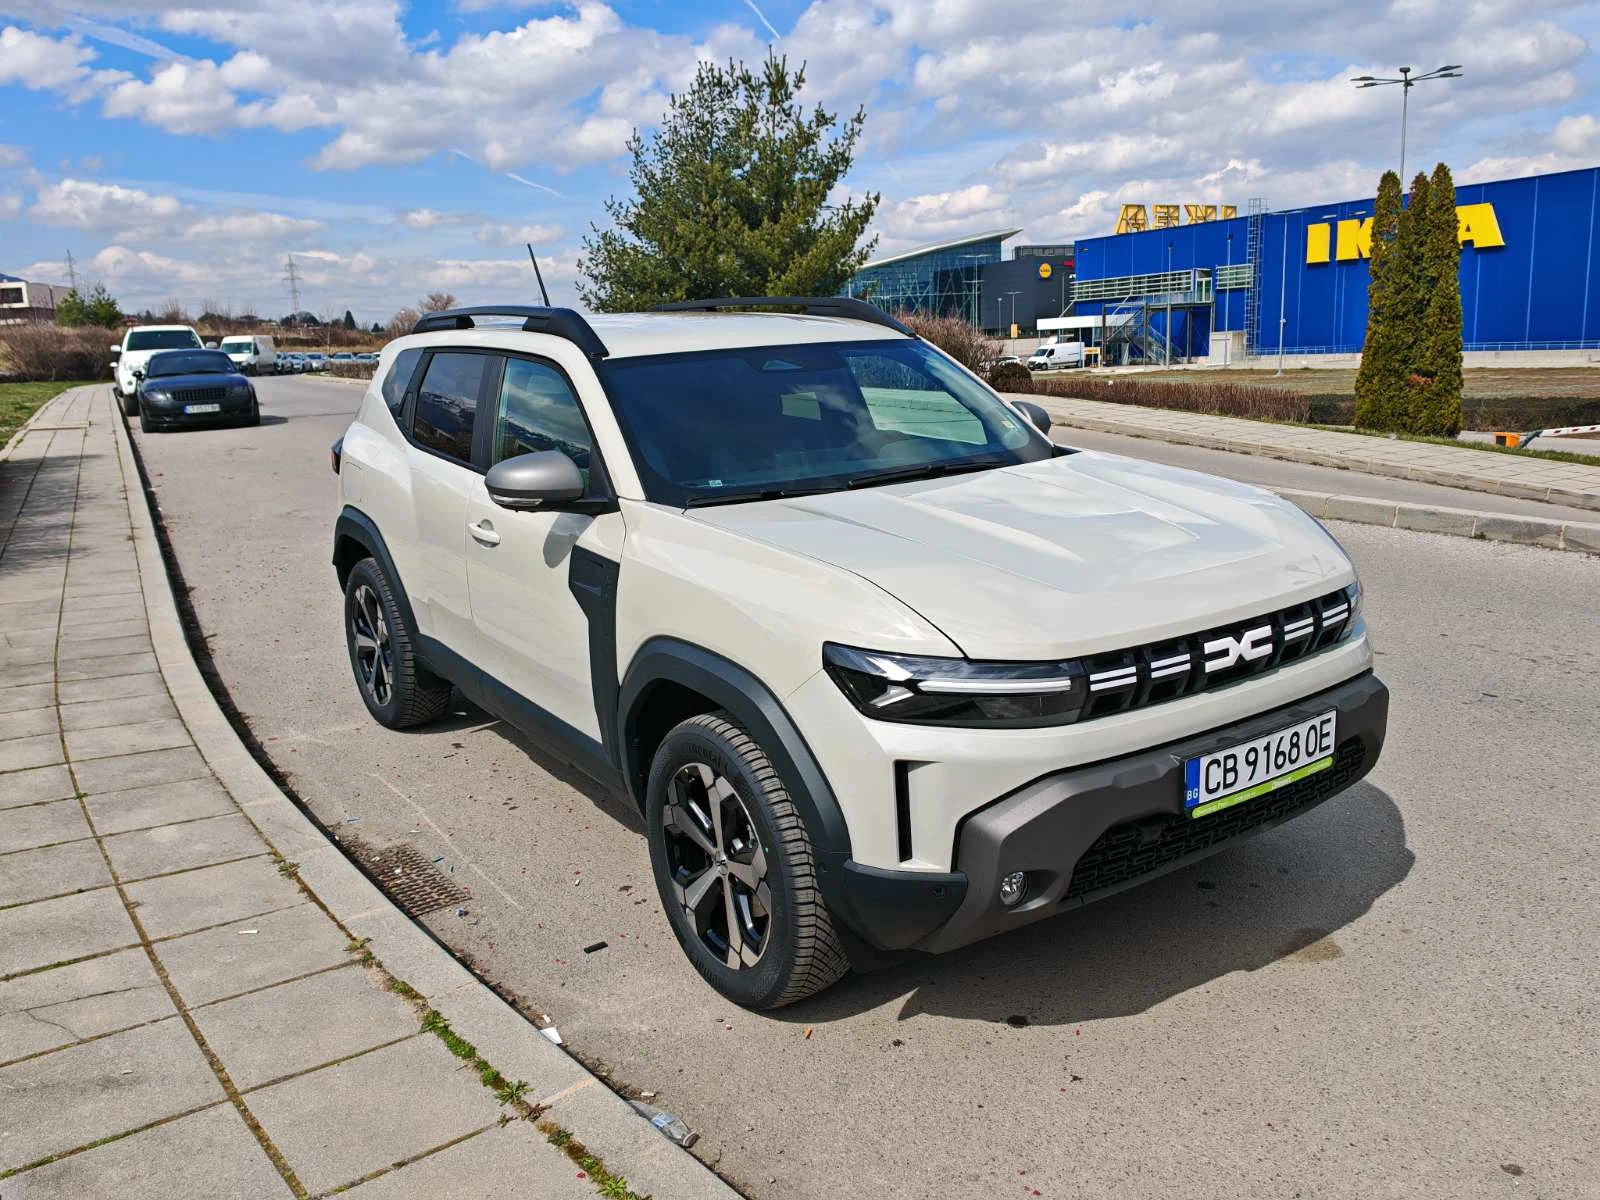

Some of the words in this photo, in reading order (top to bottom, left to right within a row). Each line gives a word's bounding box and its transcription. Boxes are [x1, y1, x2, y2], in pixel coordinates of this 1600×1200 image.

[1306, 202, 1505, 264] IKA
[1205, 754, 1238, 794] CB
[1245, 731, 1301, 781] 9168
[1306, 717, 1331, 757] OE
[1187, 788, 1199, 800] BG
